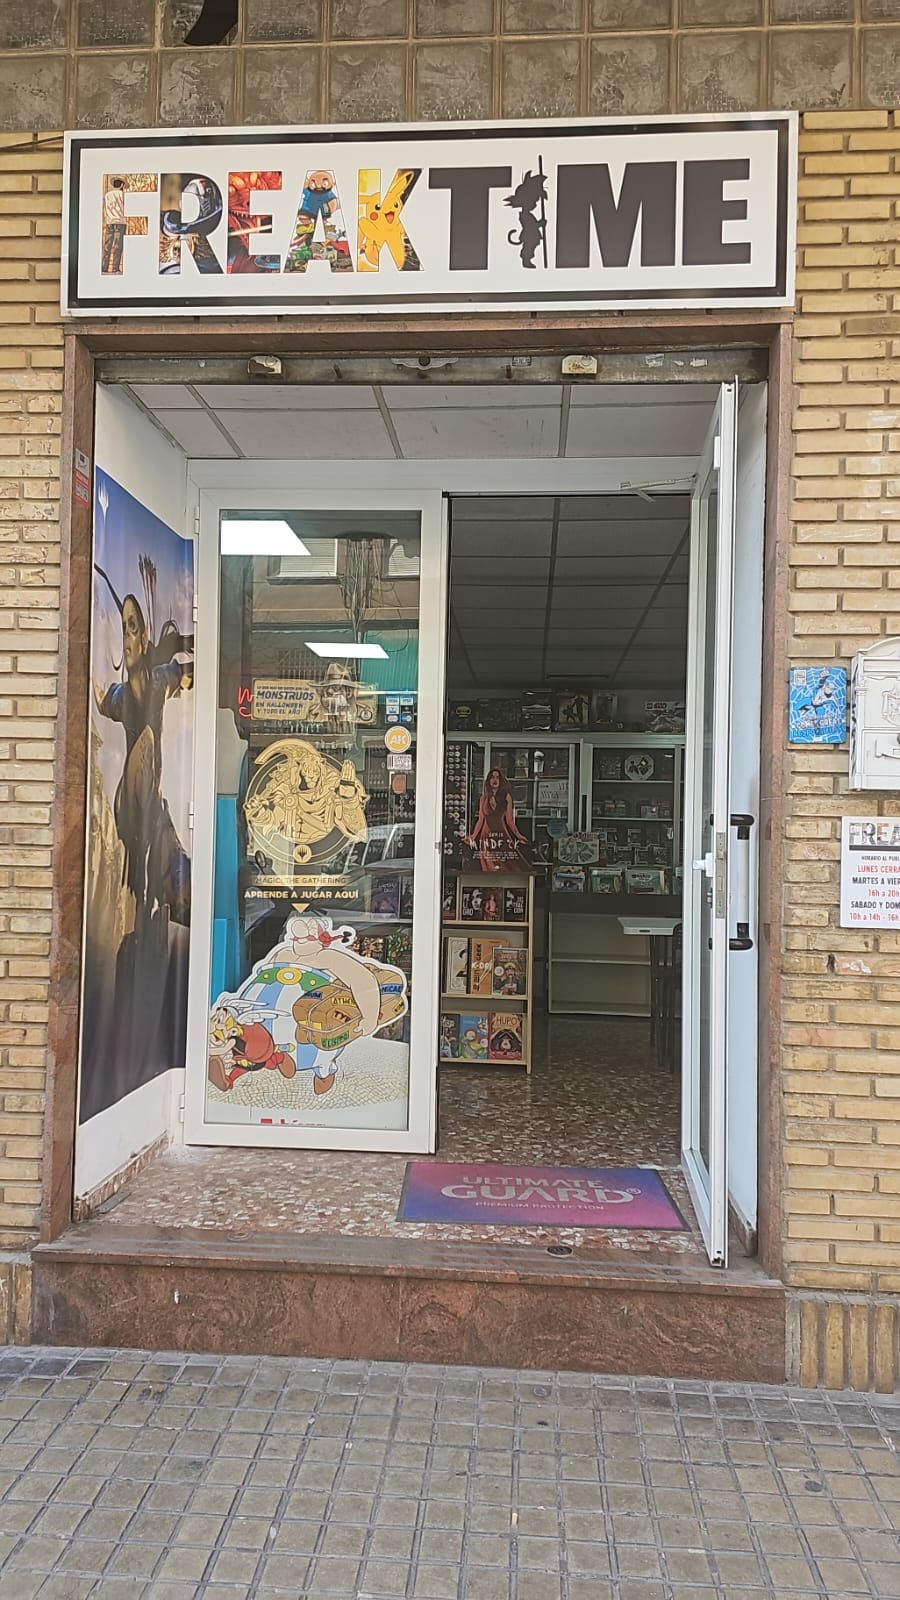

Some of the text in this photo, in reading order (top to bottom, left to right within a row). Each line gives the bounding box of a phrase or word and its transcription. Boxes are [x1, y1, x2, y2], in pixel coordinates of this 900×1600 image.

[256, 690, 314, 701] MONSTRUOS
[858, 864, 878, 872] LUNES
[852, 877, 878, 885] MARTES
[244, 889, 358, 898] APRENDE A JUGAR AQUÍ
[868, 889, 880, 897] 16h
[888, 890, 900, 898] 20h
[464, 1176, 604, 1188] ULTIMATE
